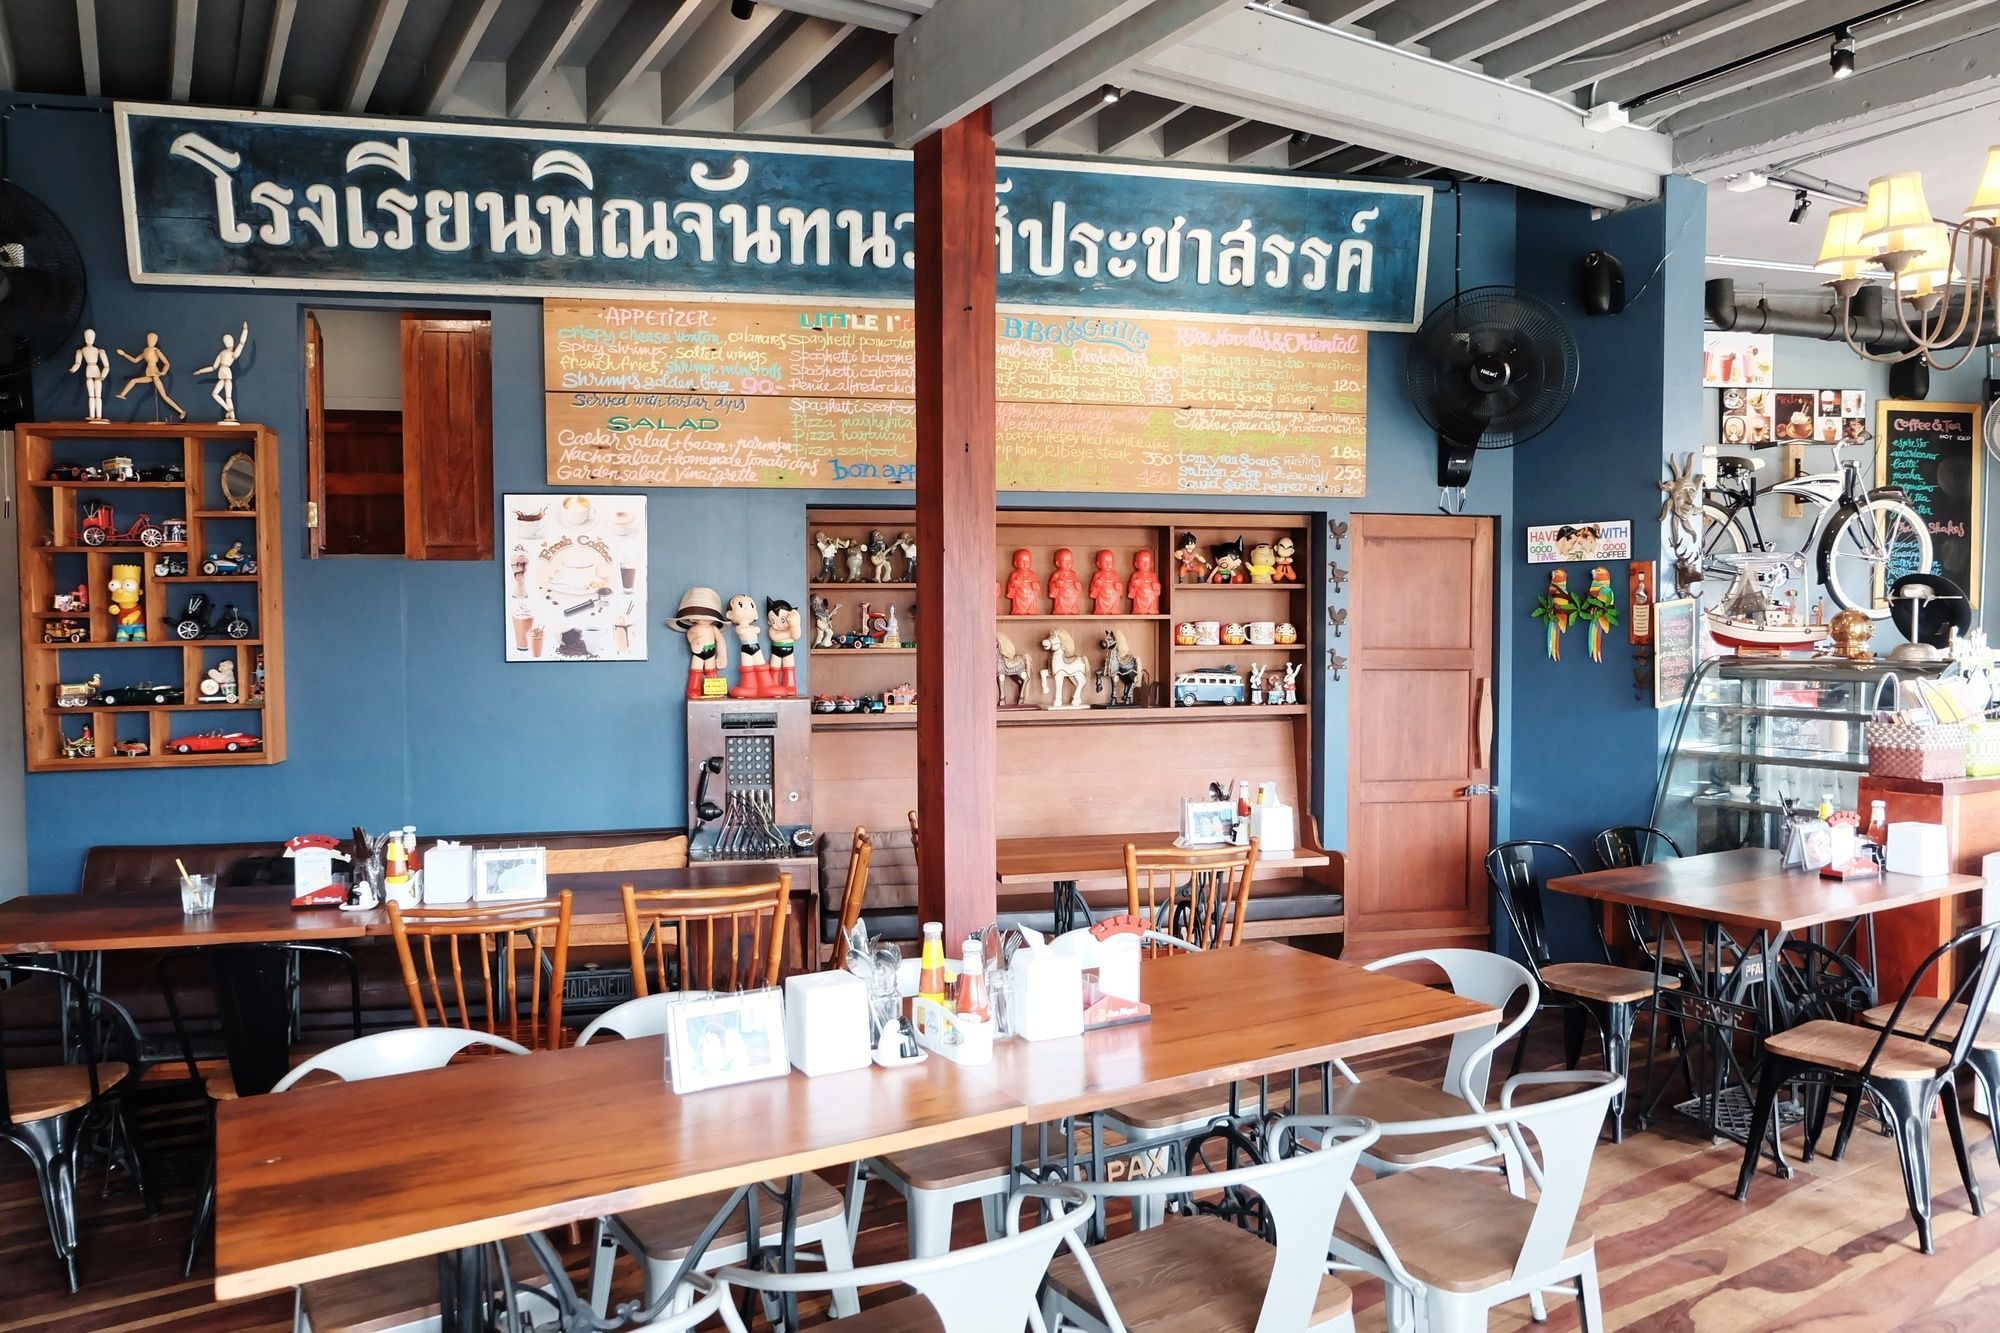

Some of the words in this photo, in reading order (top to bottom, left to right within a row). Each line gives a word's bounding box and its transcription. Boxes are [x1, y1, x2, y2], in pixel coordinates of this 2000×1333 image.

[800, 312, 879, 332] LITTLE
[885, 315, 915, 333] IT
[558, 325, 615, 345] crispy
[620, 327, 671, 343] cheese
[726, 347, 768, 371] wings
[860, 348, 915, 369] bologne
[1115, 377, 1143, 394] BBQ
[570, 393, 633, 409] Served
[606, 415, 721, 433] SALAD
[1893, 418, 1932, 432] Coffee
[1942, 420, 1963, 433] Tea
[791, 428, 838, 443] Pizza
[791, 443, 834, 459] Pizza
[1891, 438, 1930, 450] espresso
[1141, 451, 1173, 467] 350
[557, 464, 620, 480] Garden
[826, 457, 880, 481] bon
[881, 464, 915, 480] app
[1599, 527, 1627, 539] WITH
[1928, 519, 1965, 538] Shakes
[538, 534, 573, 562] Fresh
[576, 535, 613, 563] Coffee
[1529, 545, 1552, 554] GOOD
[1596, 550, 1627, 559] COFFEE
[1602, 543, 1626, 552] GOOD
[1536, 552, 1557, 561] TIME
